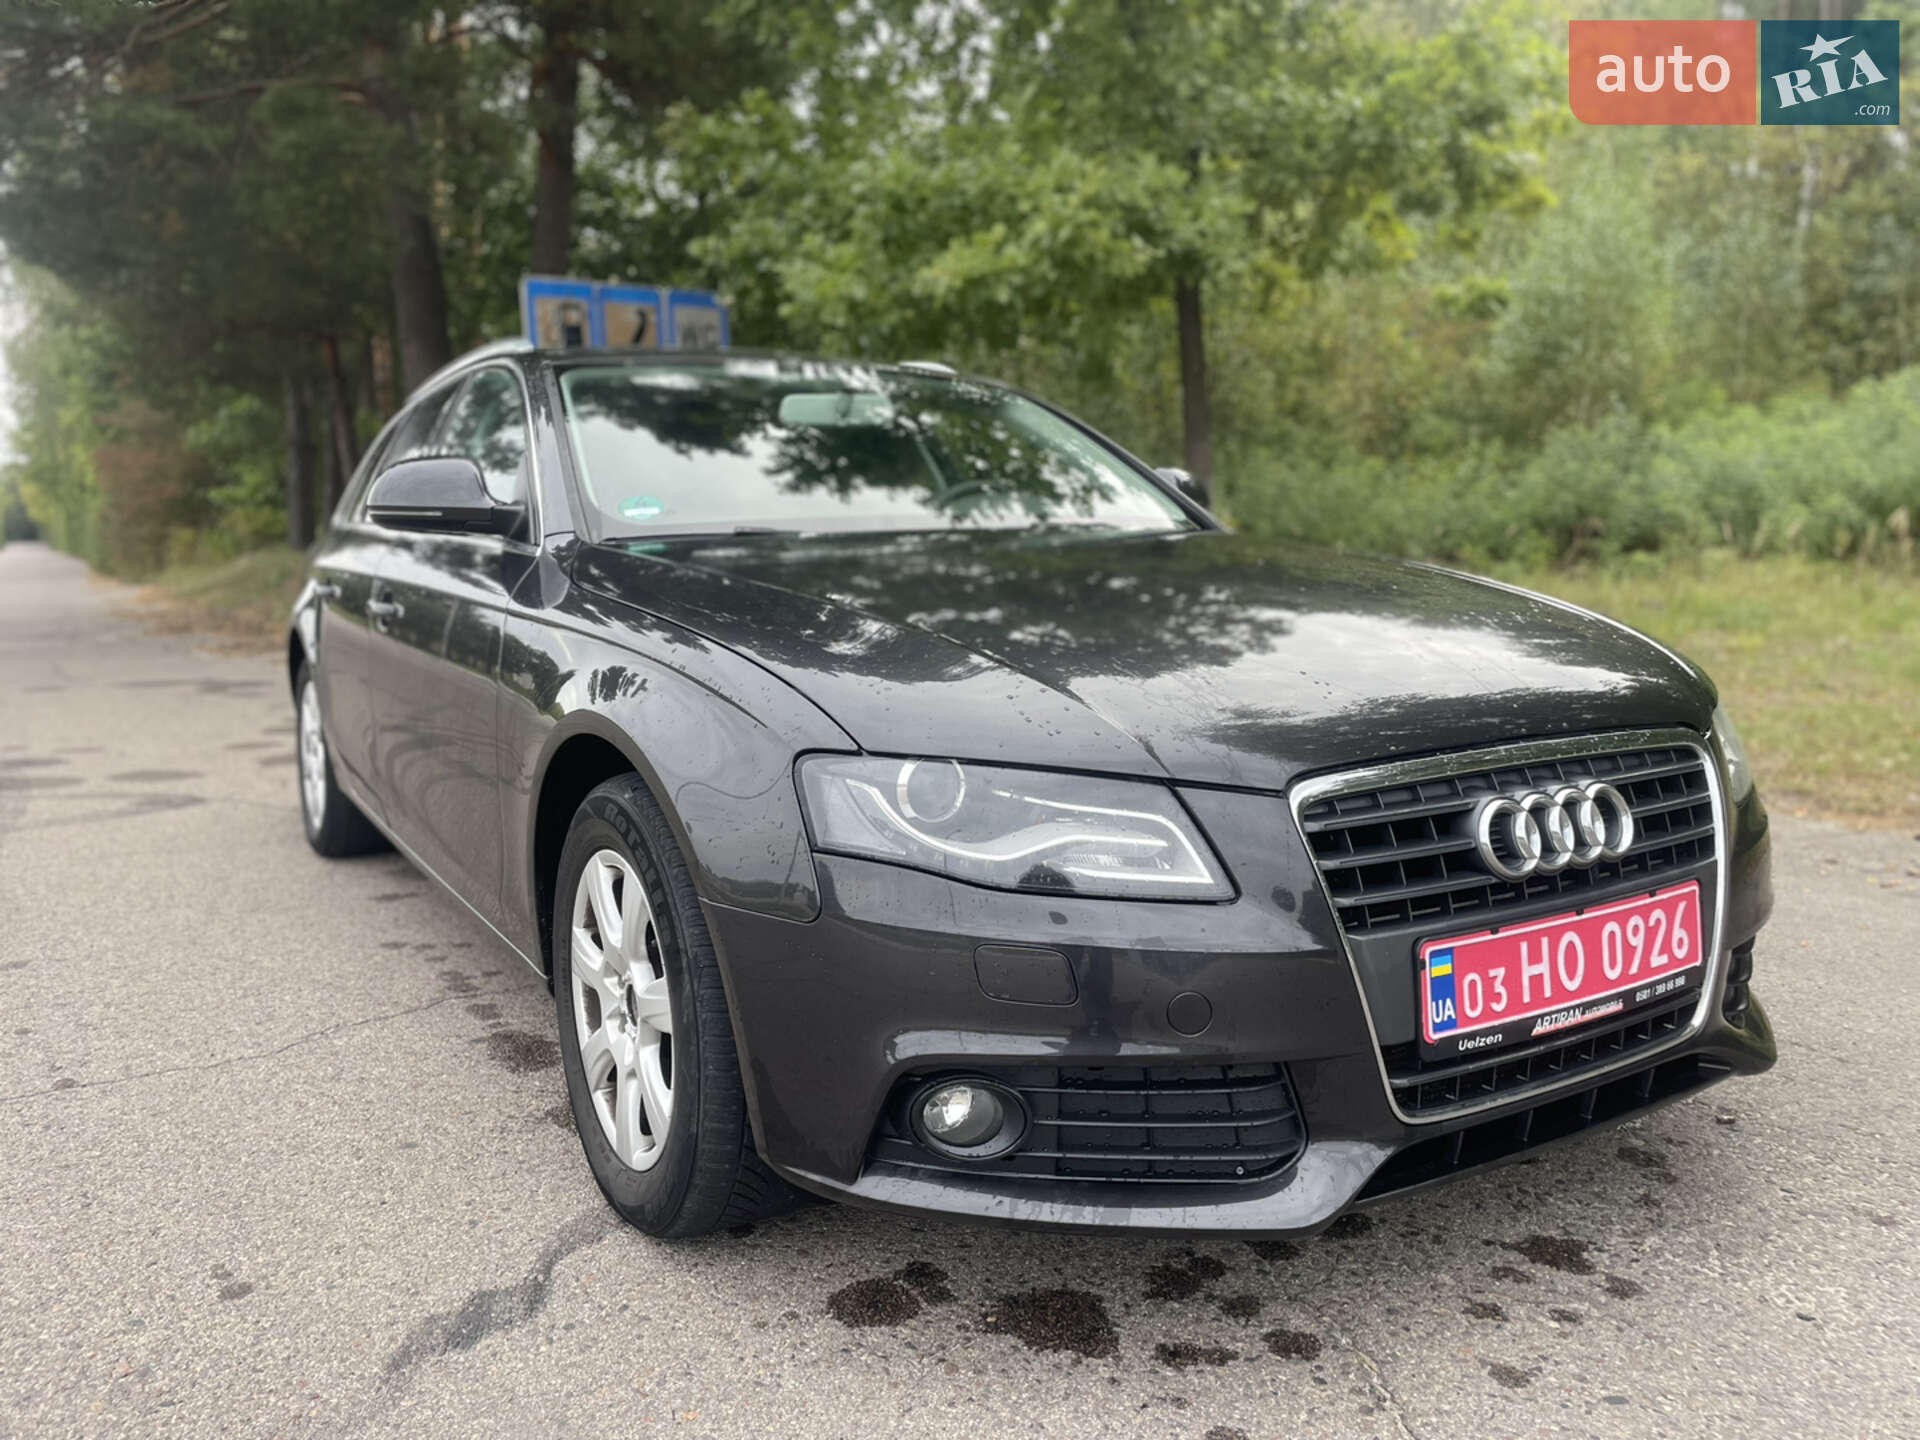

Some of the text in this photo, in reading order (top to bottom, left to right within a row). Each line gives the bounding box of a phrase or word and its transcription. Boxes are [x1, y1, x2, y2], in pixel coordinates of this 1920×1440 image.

[1462, 900, 1690, 1019] 03 HO 0926
[1432, 998, 1456, 1024] UA
[1534, 1006, 1584, 1030] ARTIRAN
[1458, 1032, 1503, 1051] Uelzen
